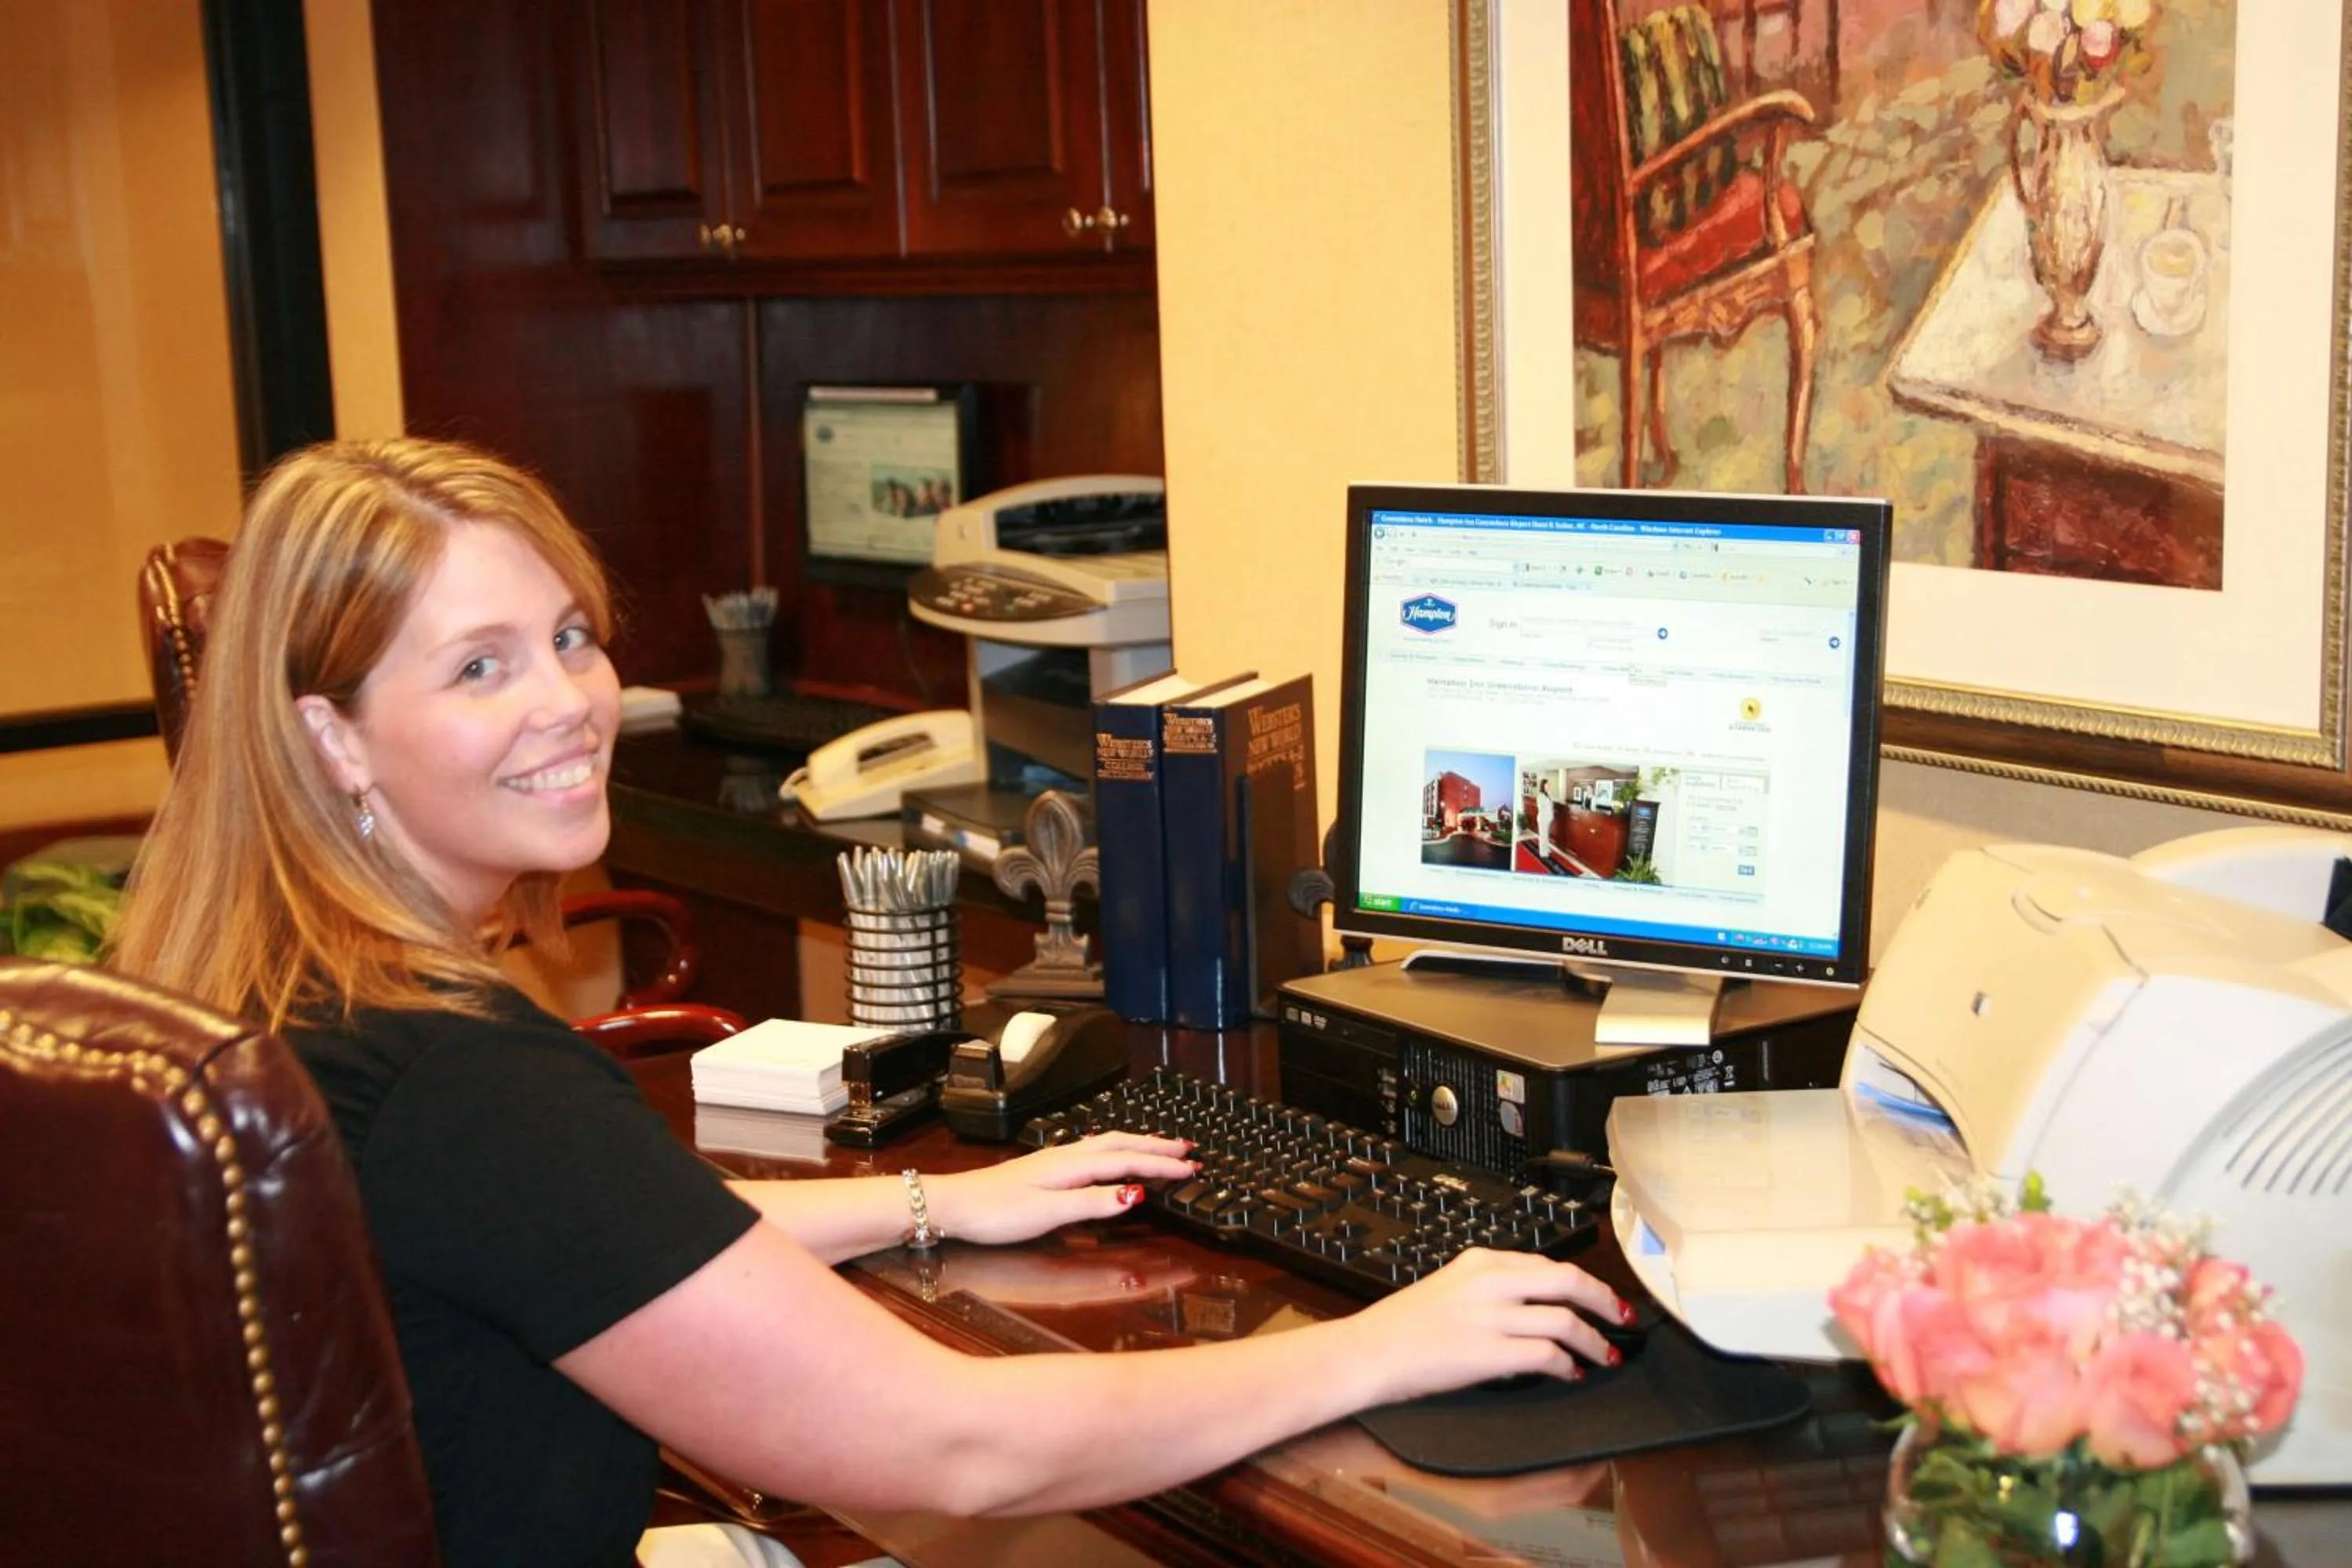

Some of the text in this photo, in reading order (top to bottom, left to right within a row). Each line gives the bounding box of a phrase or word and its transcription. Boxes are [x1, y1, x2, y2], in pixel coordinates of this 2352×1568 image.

[1403, 605, 1456, 622] Hampton
[1489, 618, 1507, 630] Sign
[1563, 936, 1608, 956] DELL
